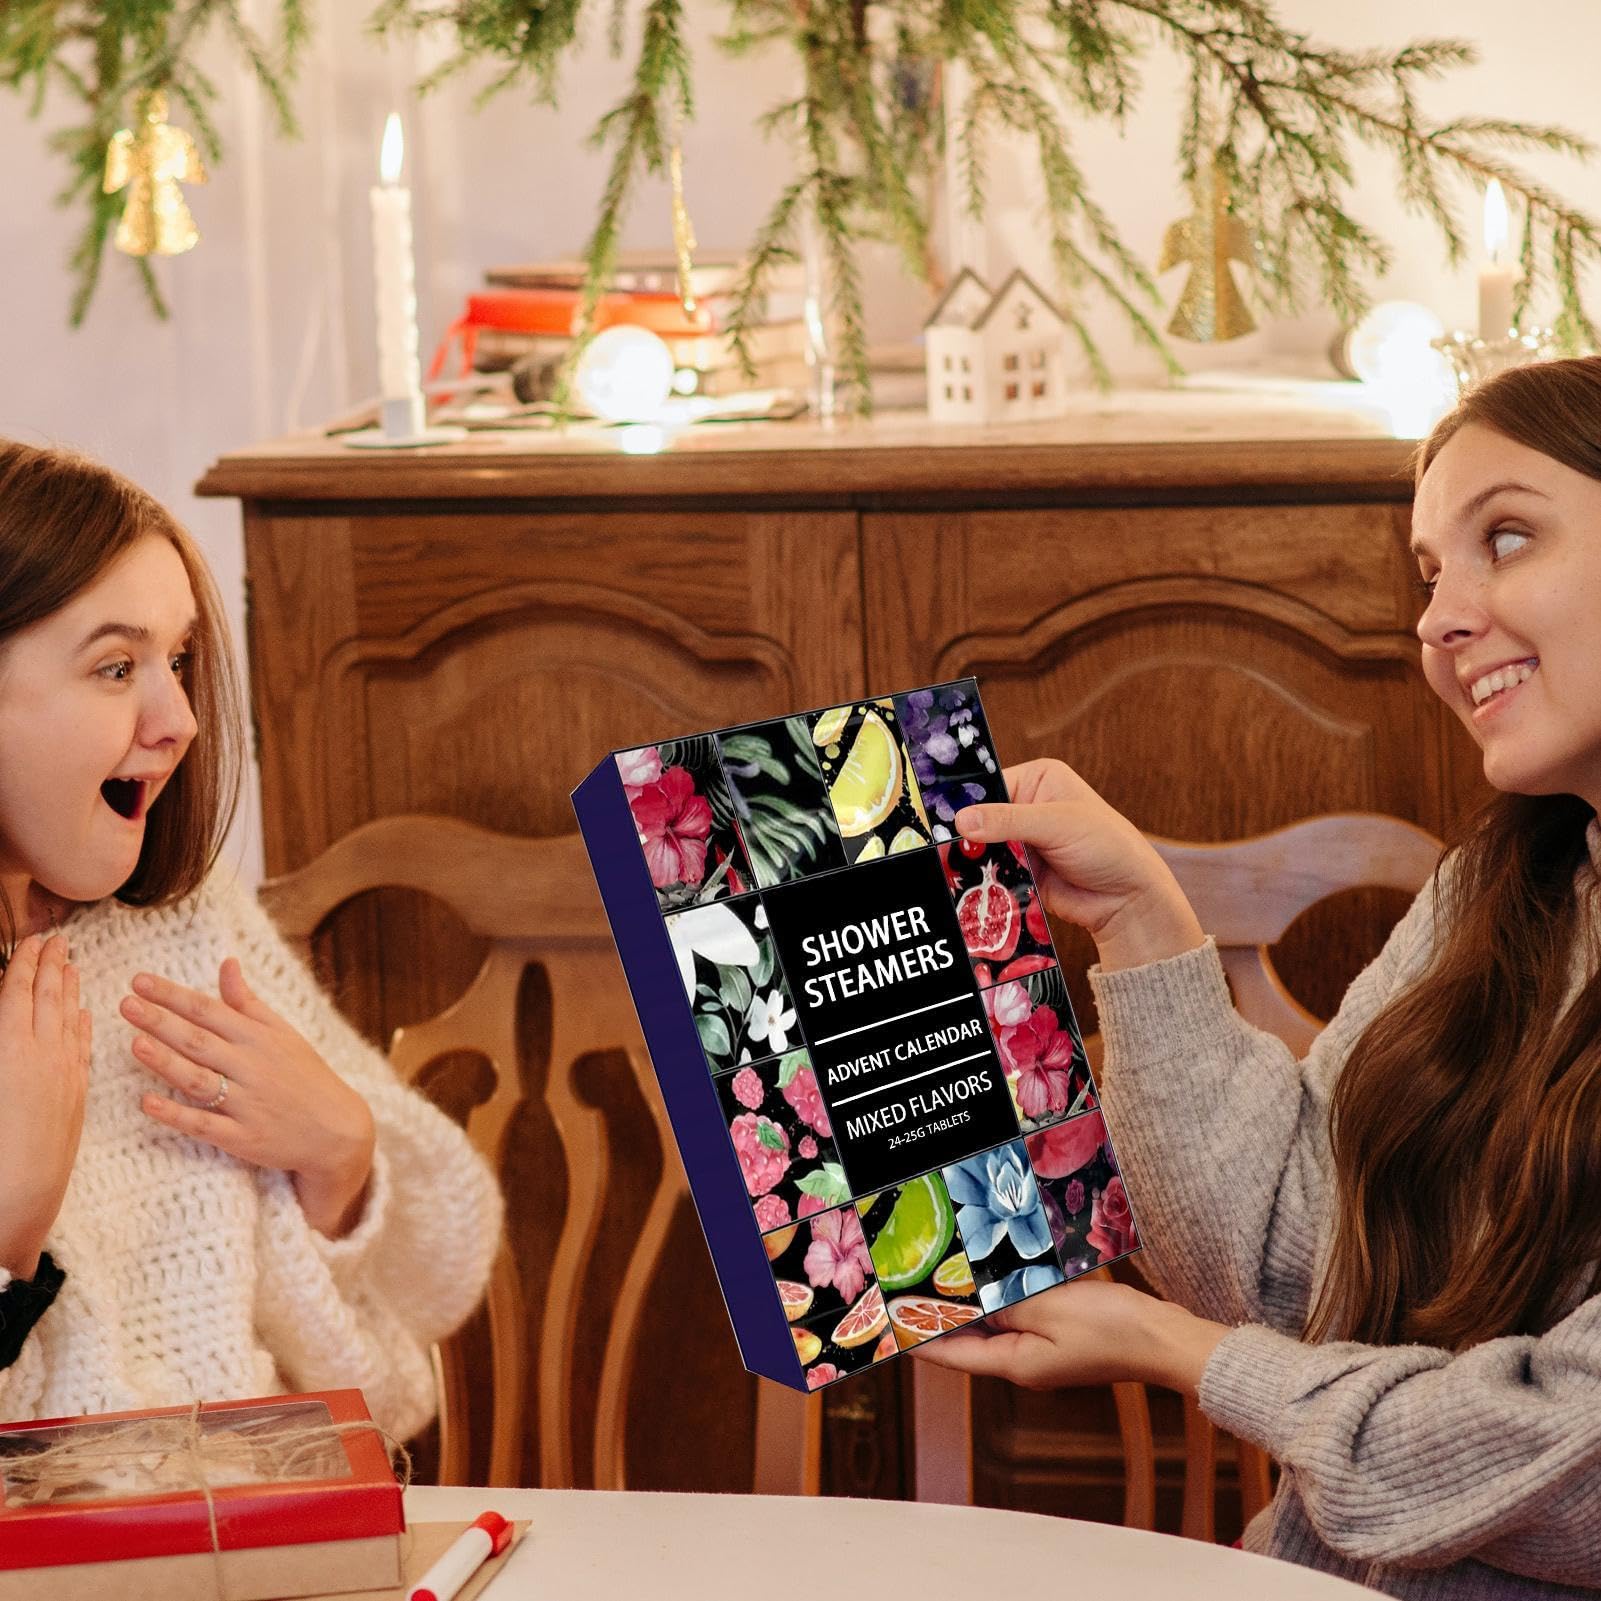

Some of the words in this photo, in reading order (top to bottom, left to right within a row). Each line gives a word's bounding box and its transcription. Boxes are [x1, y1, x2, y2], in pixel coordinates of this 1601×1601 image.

[802, 907, 930, 966] SHOWER
[805, 939, 953, 1007] STEAMERS
[828, 1049, 890, 1085] ADVENT
[895, 1019, 983, 1060] CALENDAR
[846, 1104, 906, 1139] MIXED
[909, 1071, 992, 1117] FLAVORS
[888, 1127, 925, 1149] 24-25G
[926, 1111, 970, 1134] TABLETS
